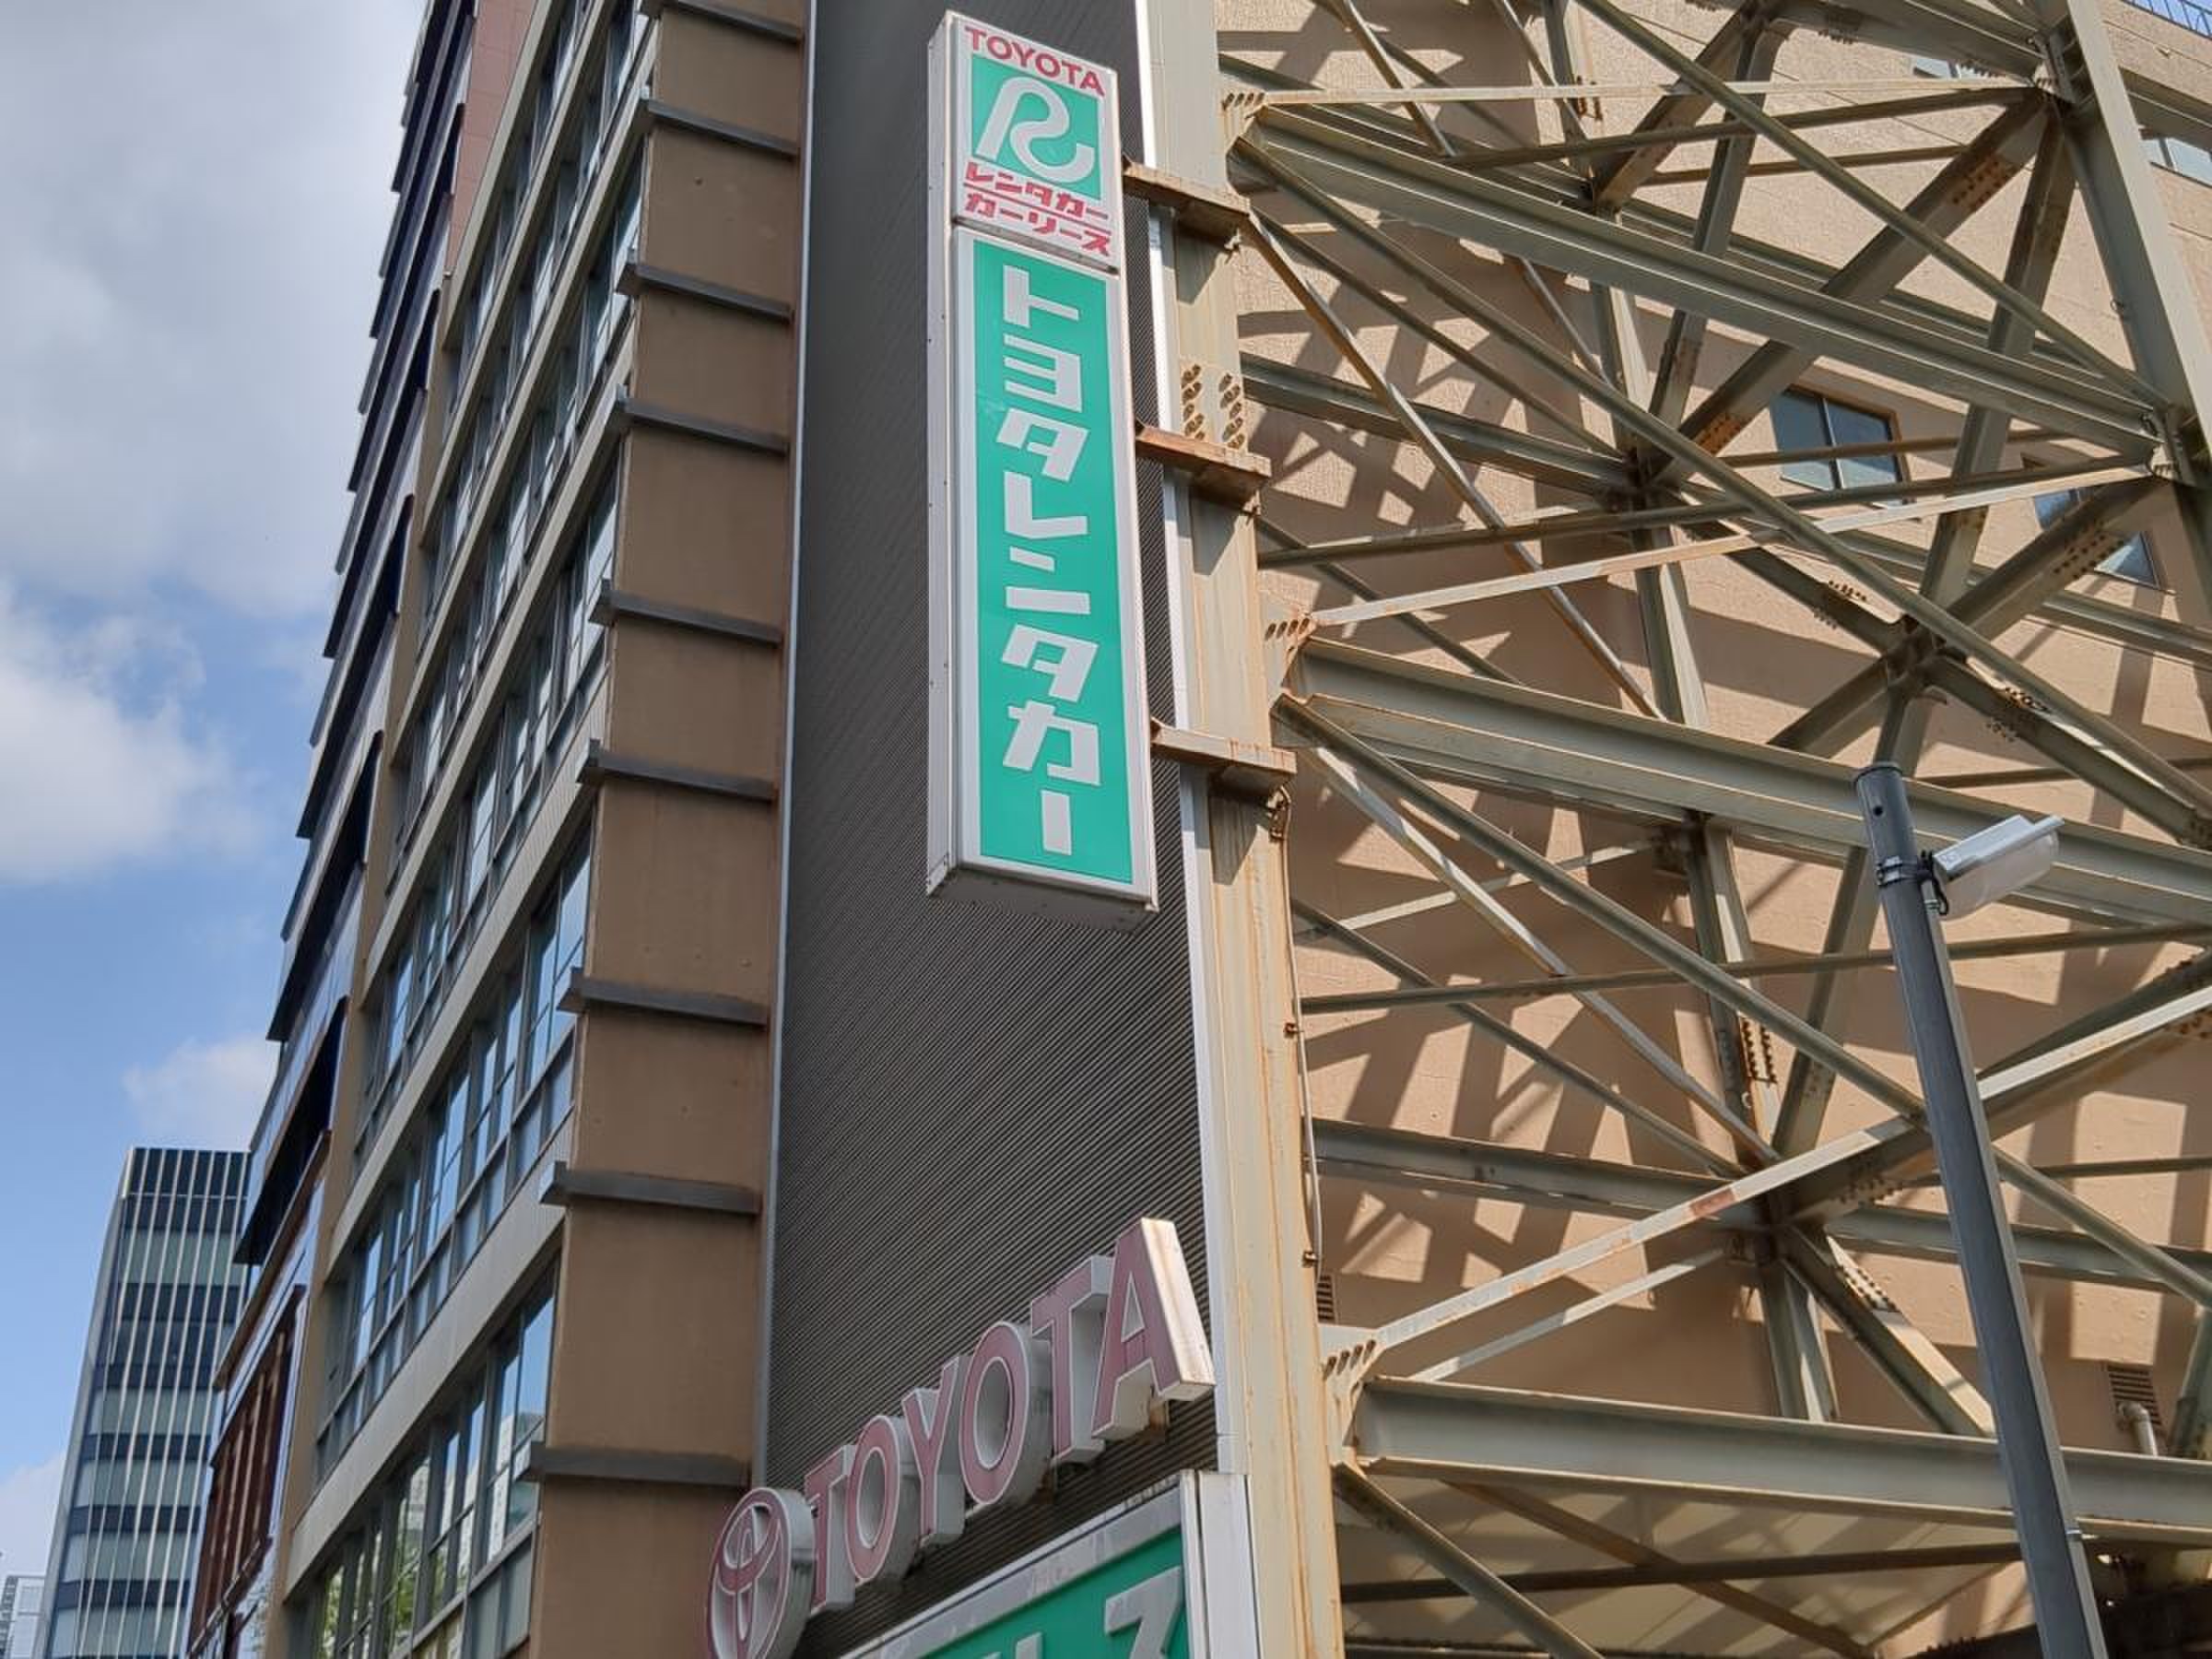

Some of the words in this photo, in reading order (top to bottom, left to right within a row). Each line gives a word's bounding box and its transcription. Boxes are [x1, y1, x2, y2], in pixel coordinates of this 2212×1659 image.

[965, 26, 1105, 97] TOYOTA
[965, 193, 1112, 256] カーリース
[966, 161, 1109, 219] レンタカー
[996, 264, 1101, 856] トヨタレンタカー
[804, 1218, 1207, 1615] TOYOTA
